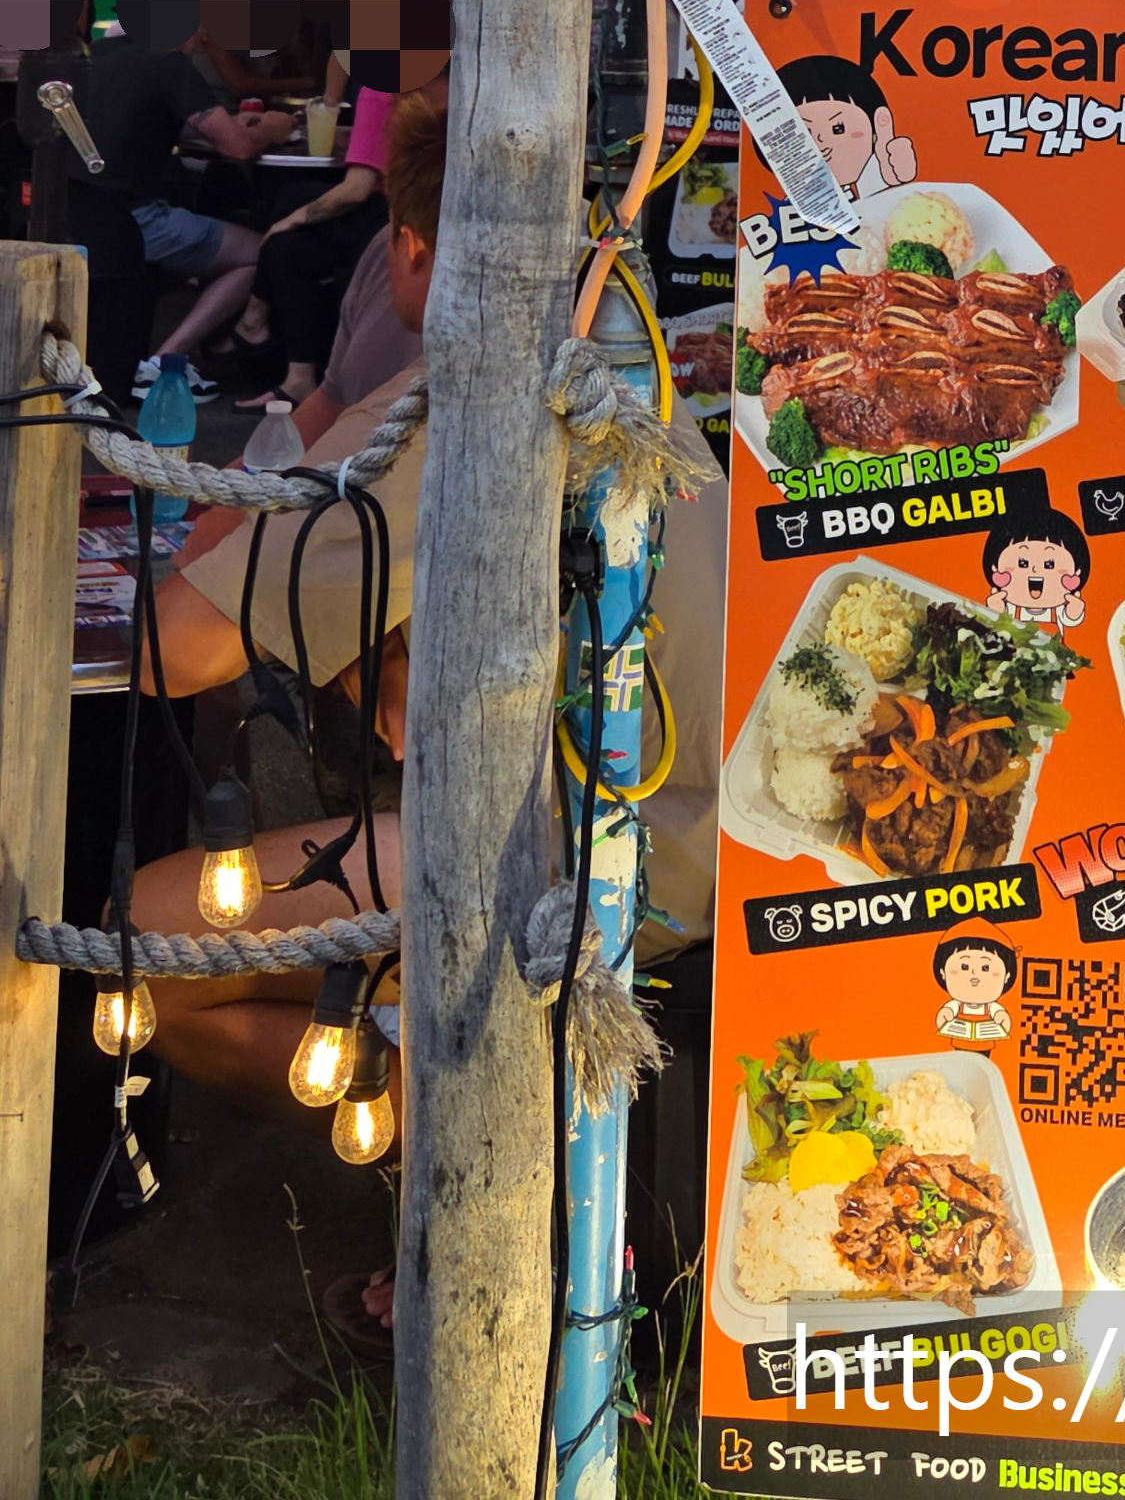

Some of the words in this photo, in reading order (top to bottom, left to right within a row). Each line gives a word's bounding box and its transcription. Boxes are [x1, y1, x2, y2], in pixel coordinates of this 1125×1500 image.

[740, 203, 861, 260] BE
[671, 272, 701, 284] BEEF
[769, 452, 907, 503] "SHORT
[906, 439, 1011, 482] RIBS"
[822, 506, 897, 540] BBQ
[902, 486, 1008, 528] GALBI
[810, 892, 924, 934] SPICY
[925, 876, 1026, 920] PORK
[1020, 1106, 1093, 1128] ONLINE
[811, 1339, 903, 1380] BEEF
[911, 1322, 1069, 1369] BULGOGI
[768, 1441, 889, 1475] STREET
[911, 1451, 987, 1483] FOOD
